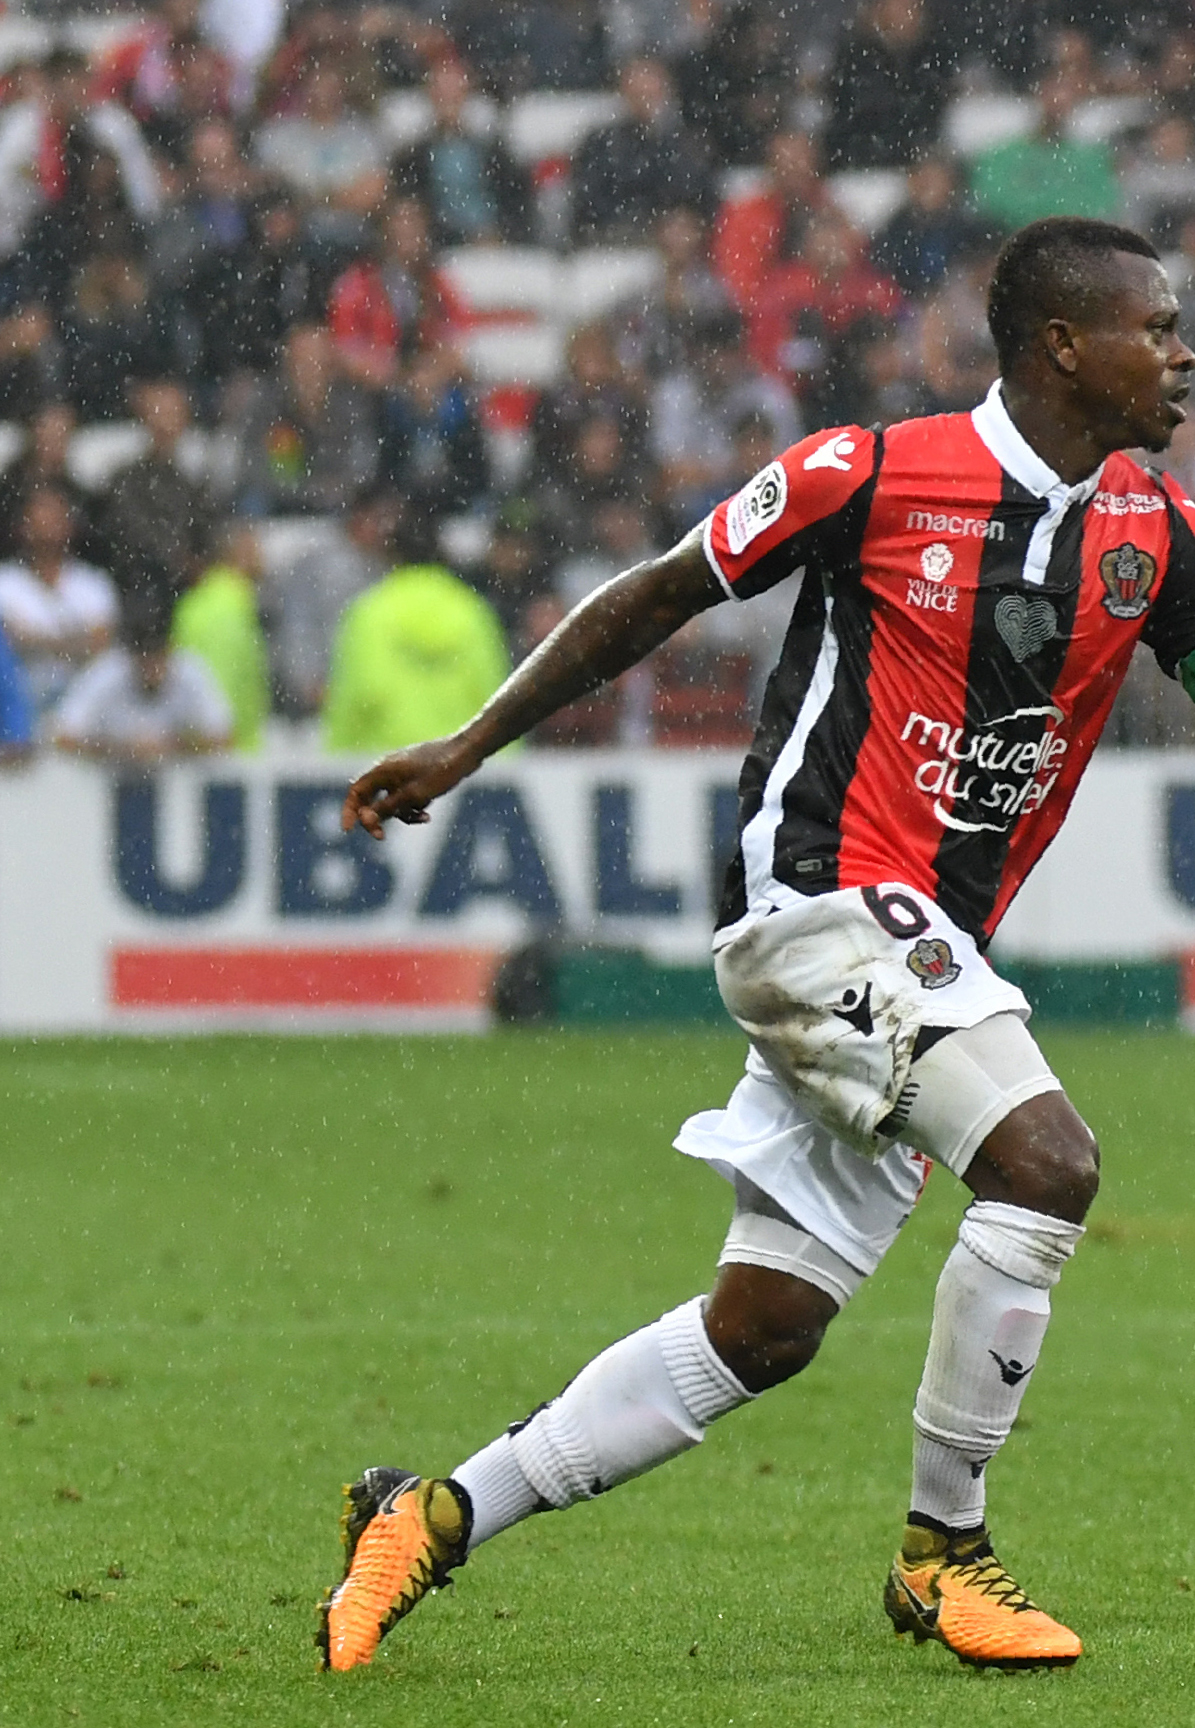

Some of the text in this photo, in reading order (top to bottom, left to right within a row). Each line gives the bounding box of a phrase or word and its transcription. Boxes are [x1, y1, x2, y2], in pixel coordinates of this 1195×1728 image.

[906, 511, 1005, 541] macron
[905, 589, 958, 612] NICE
[907, 578, 960, 597] VILLE DE
[915, 760, 979, 801] du
[116, 782, 745, 918] UBAL
[860, 885, 932, 940] 6
